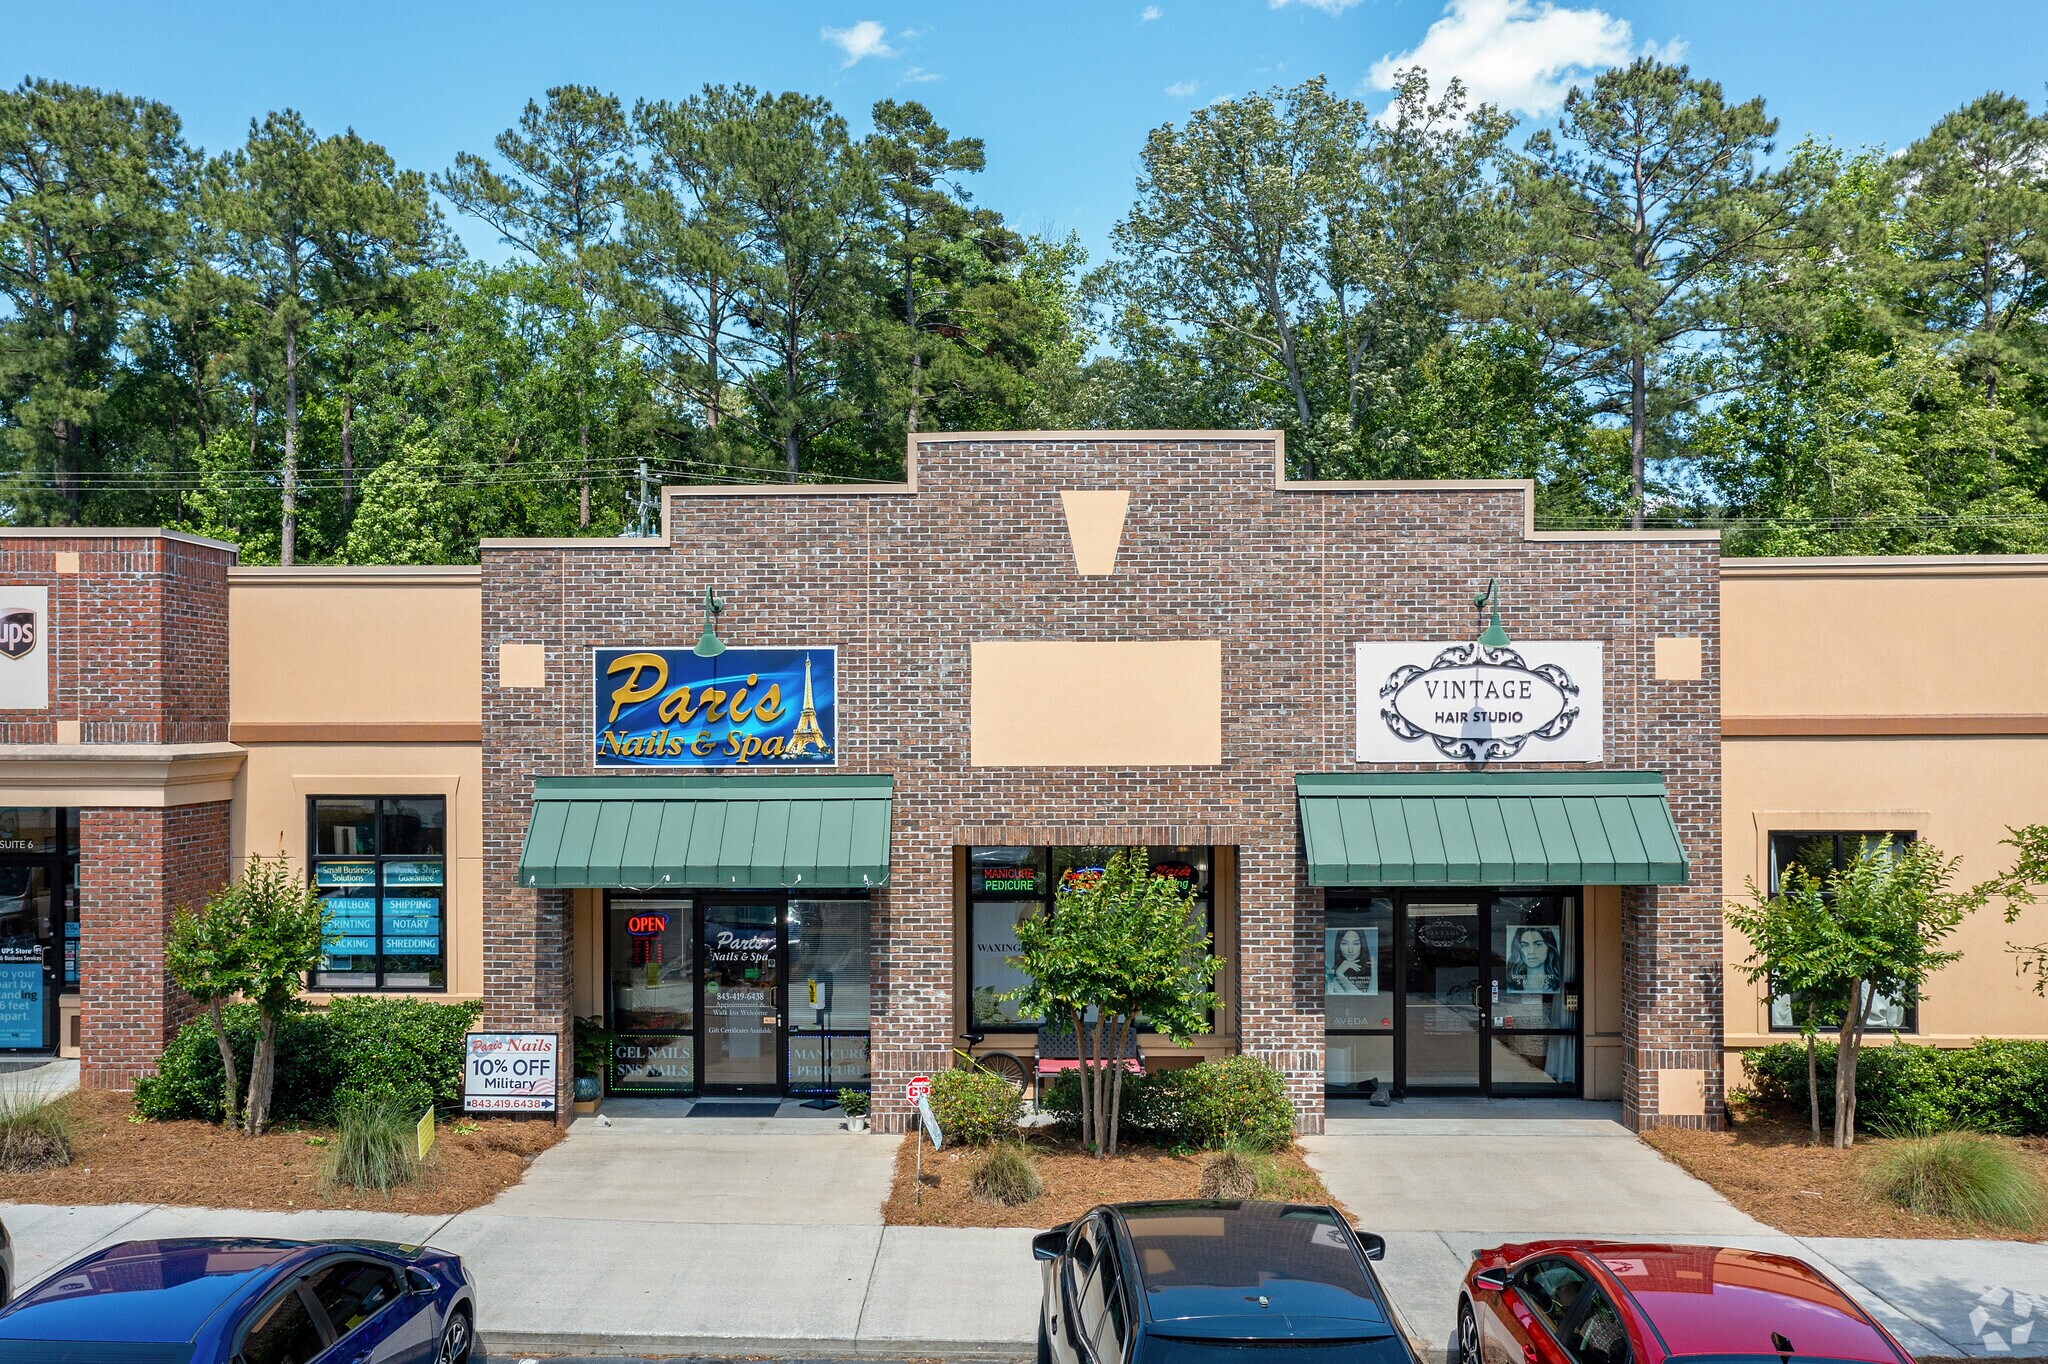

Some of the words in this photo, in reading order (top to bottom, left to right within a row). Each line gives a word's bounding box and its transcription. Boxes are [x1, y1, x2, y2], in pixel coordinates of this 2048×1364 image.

[607, 652, 786, 724] Paris
[1424, 680, 1532, 699] VINTAGE
[1435, 711, 1468, 724] HAIR
[1473, 711, 1523, 723] STUDIO
[598, 729, 685, 756] Nails
[690, 731, 718, 756] &
[723, 730, 785, 764] Spa
[0, 840, 26, 849] SUITE
[27, 840, 34, 849] 6
[322, 866, 342, 874] Small
[343, 866, 372, 874] Business
[984, 868, 1034, 879] MANICURE
[1155, 864, 1192, 877] Nails
[332, 874, 364, 882] Solutions
[398, 874, 434, 882] Guarantee
[985, 880, 1034, 891] PEDICURE
[328, 901, 370, 909] MAILBOX
[390, 900, 432, 909] SHIPPING
[328, 920, 370, 929] PRINTING
[392, 920, 429, 929] NOTARY
[629, 917, 665, 932] OPEN
[386, 939, 436, 948] SHREDDING
[717, 931, 764, 950] Paris
[977, 943, 1021, 952] WAXING
[712, 952, 739, 961] Nails
[740, 952, 749, 961] &
[750, 952, 769, 963] Spa
[0, 970, 8, 978] o
[11, 971, 37, 980] your
[0, 981, 18, 989] art
[20, 981, 34, 990] by
[0, 990, 38, 1001] anding
[716, 992, 764, 1001] 843-419-6438
[8, 1001, 30, 1010] feet
[1333, 1017, 1369, 1026] AVEDA
[471, 1039, 503, 1053] Paris
[507, 1038, 552, 1052] Nails
[615, 1046, 647, 1059] GEL
[648, 1046, 690, 1059] NAILS
[472, 1059, 508, 1076] 10%
[513, 1059, 550, 1076] OFF
[617, 1064, 644, 1077] SNS
[647, 1064, 689, 1077] NAILS
[484, 1077, 537, 1092] Military
[471, 1099, 541, 1108] 843.419.6438
